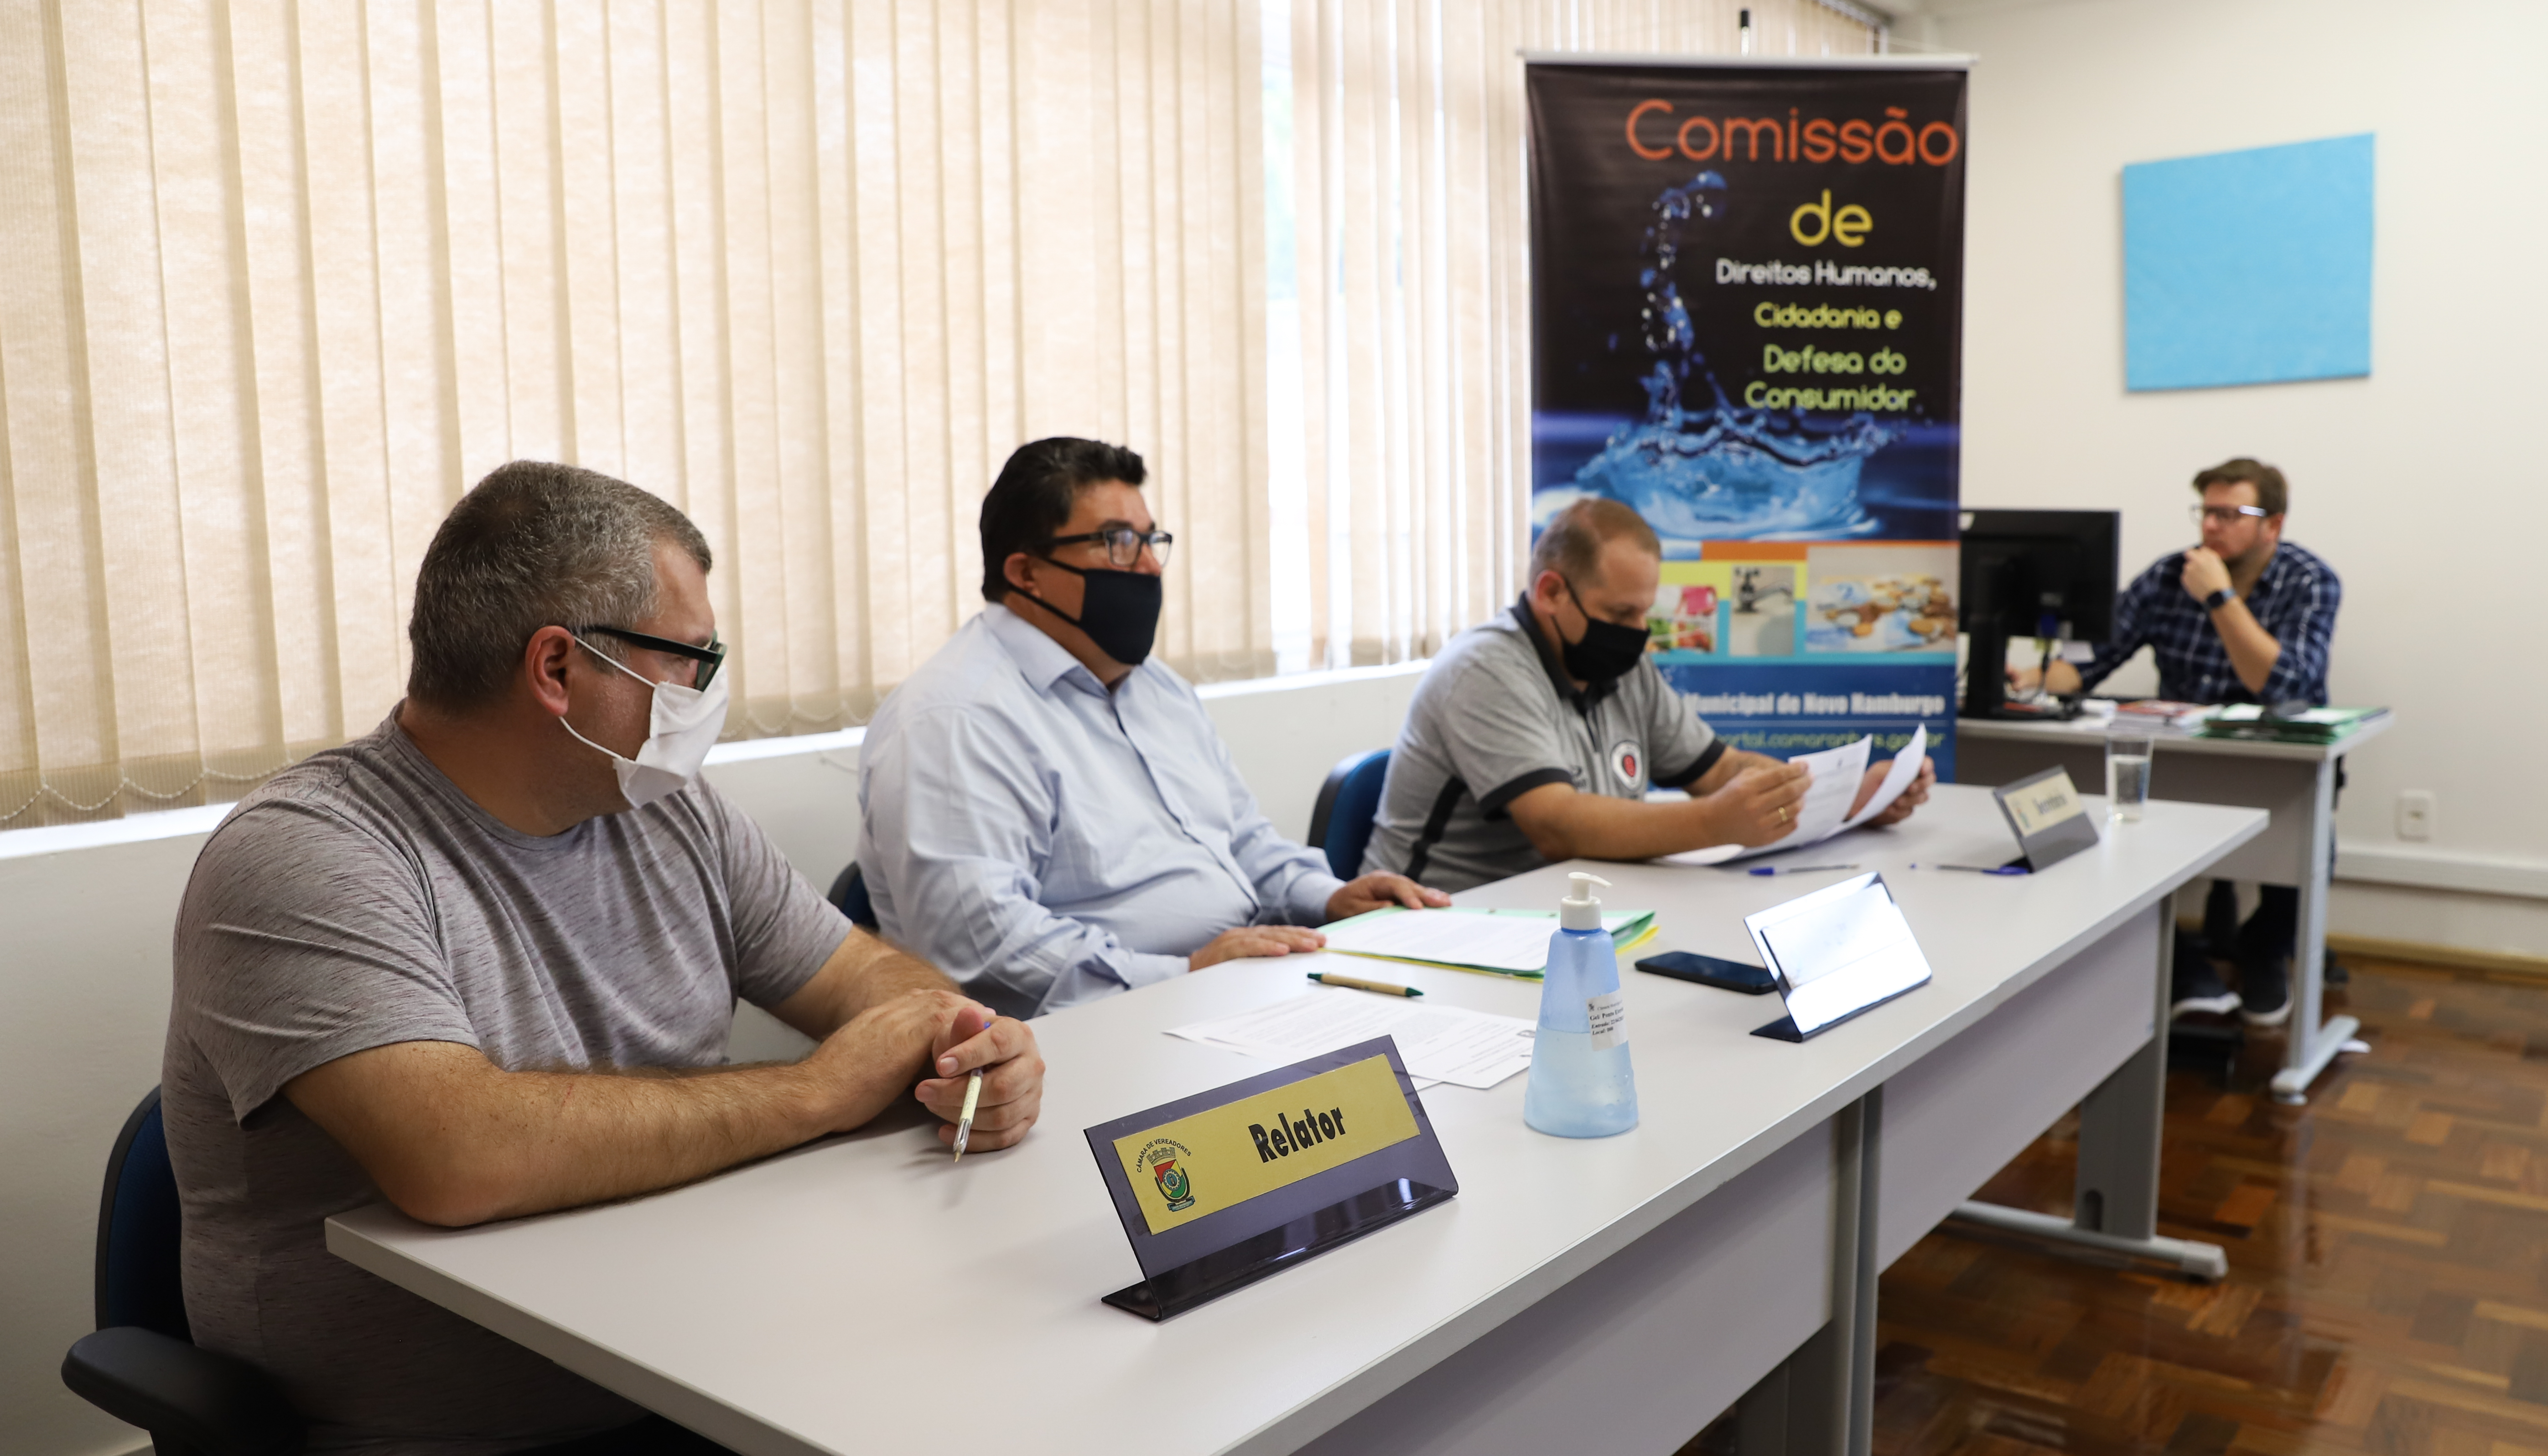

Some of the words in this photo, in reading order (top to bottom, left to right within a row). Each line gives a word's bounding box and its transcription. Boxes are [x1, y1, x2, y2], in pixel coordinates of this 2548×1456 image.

[1625, 98, 1959, 166] Comissão
[1789, 188, 1874, 247] de
[1715, 257, 1811, 285] Direitos
[1815, 259, 1937, 291] Humanos,
[1754, 301, 1880, 329] Cidadania
[1884, 308, 1902, 329] e
[1763, 344, 1864, 374] Defesa
[1868, 346, 1907, 375] do
[1744, 380, 1916, 411] Consumidor
[1803, 691, 1848, 715] Novo
[1850, 691, 1946, 717] Hamburgo
[1248, 1107, 1346, 1163] Relator
[1136, 1147, 1148, 1173] CÂMARA
[1146, 1141, 1154, 1150] DE
[1154, 1138, 1192, 1157] VEREADORES
